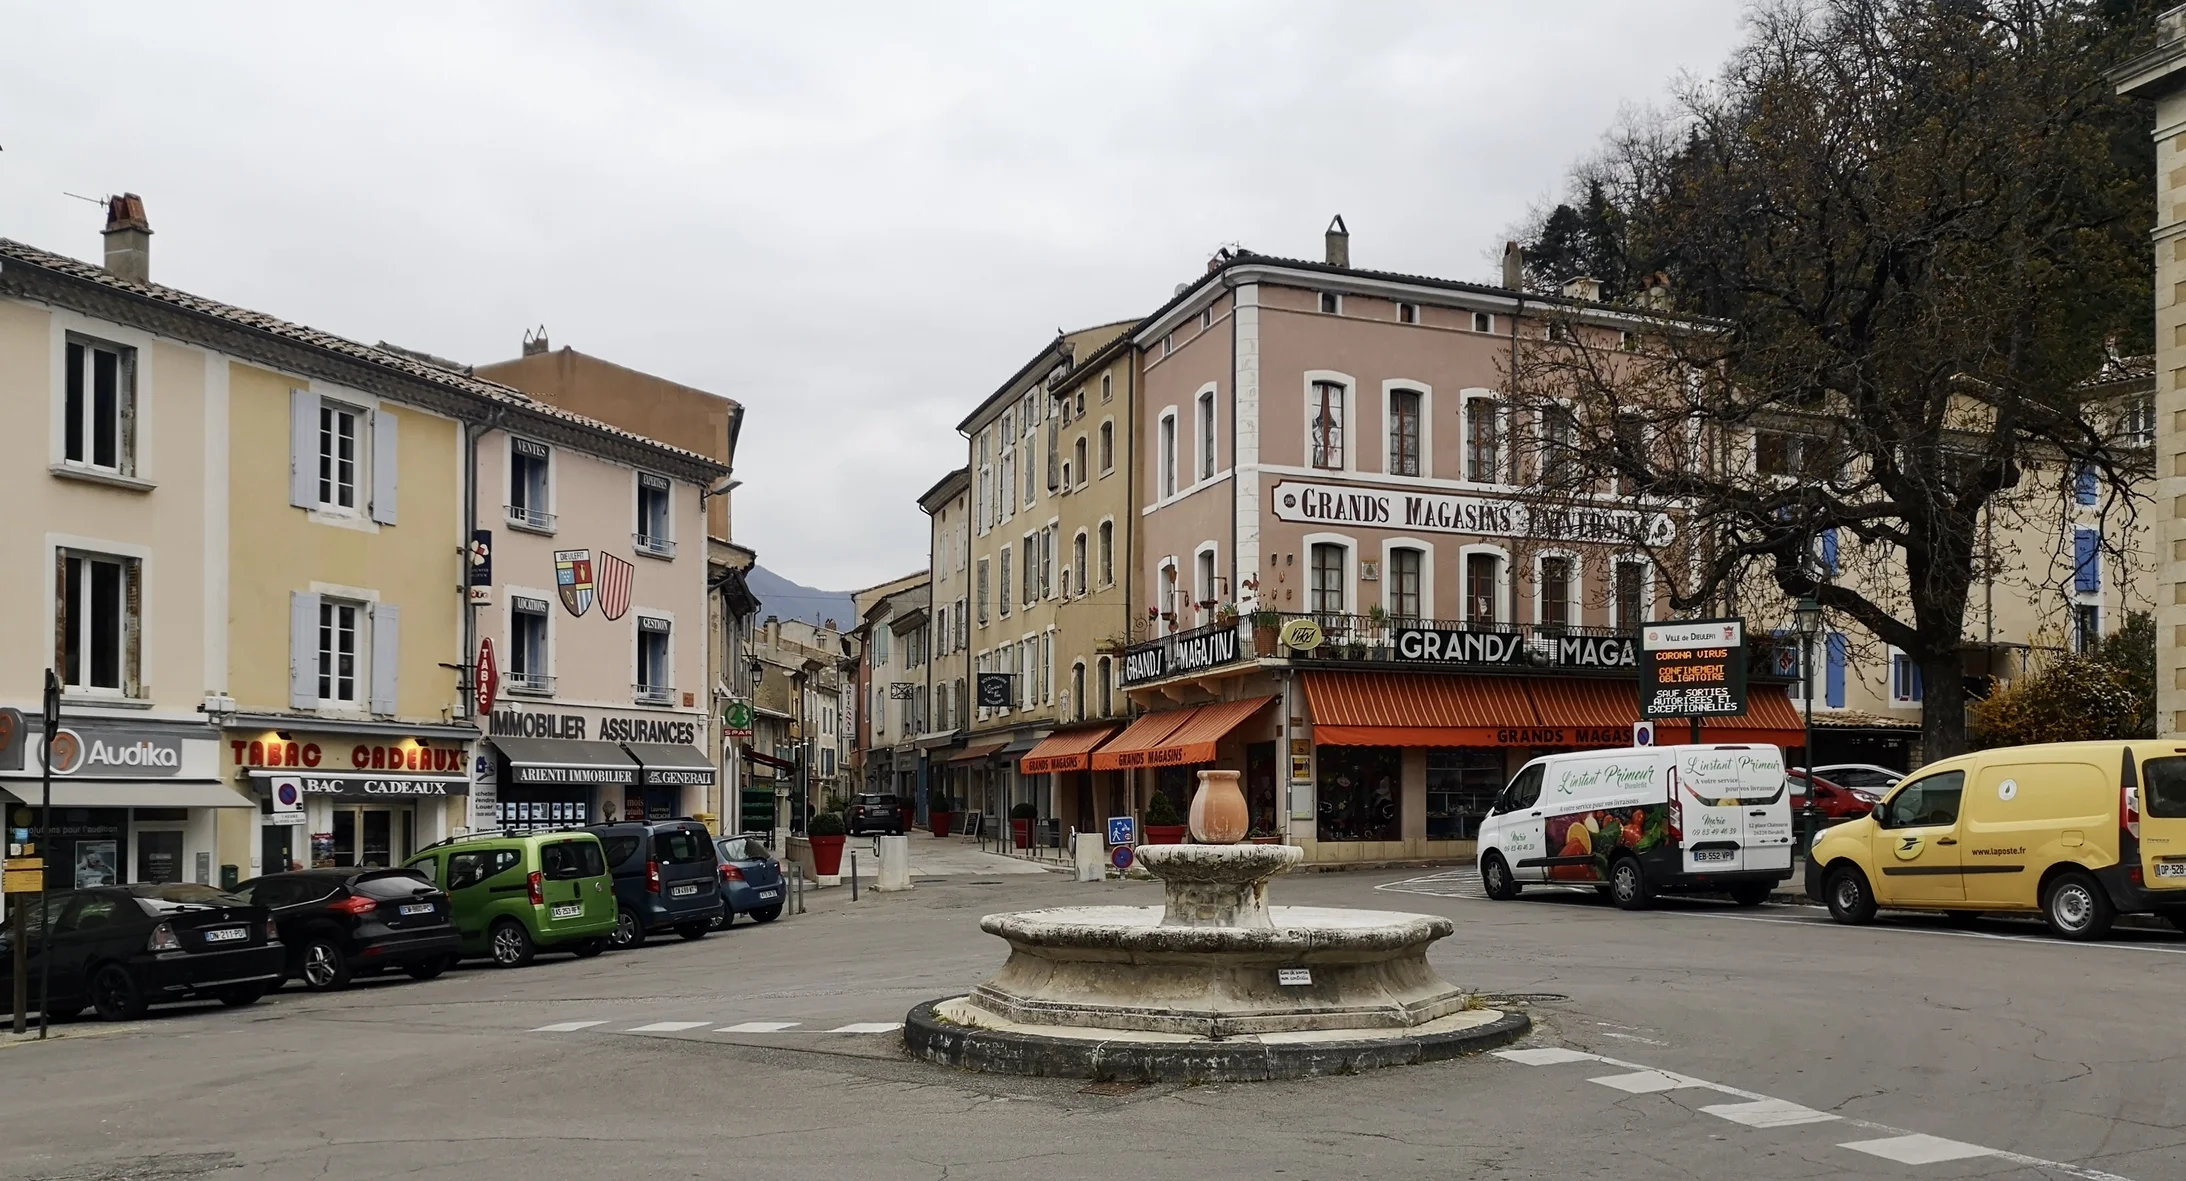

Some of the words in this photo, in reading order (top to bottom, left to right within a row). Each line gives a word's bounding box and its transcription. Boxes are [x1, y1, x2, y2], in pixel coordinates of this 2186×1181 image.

[517, 440, 546, 458] VENTES
[1301, 487, 1390, 524] GRANDS
[1405, 496, 1512, 533] MAGASINS
[560, 551, 585, 561] DIEULEFIT
[517, 597, 547, 613] LOCATIONS
[643, 617, 669, 631] GESTION
[1665, 634, 1680, 642] VILLE
[1126, 649, 1163, 681] GRANDS
[1180, 629, 1235, 669] MAGASINS
[1400, 630, 1521, 663] GRANDS
[1559, 637, 1638, 666] MAGA
[1656, 651, 1692, 661] CORONA
[1697, 649, 1728, 659] VIRUS
[479, 648, 489, 704] TABAC
[1658, 664, 1725, 675] CONFINEMENT
[1659, 672, 1725, 684] OBLIGATOIRE
[1653, 695, 1714, 707] AUTORISEES
[1718, 694, 1732, 704] ET
[1656, 689, 1681, 699] SAUF
[1685, 687, 1729, 698] SORTIES
[1647, 702, 1738, 714] EXCEPTIONNELLES
[489, 710, 586, 740] IMMOBILIER
[600, 717, 695, 744] ASSURANCES
[1497, 729, 1564, 743] GRANDS
[87, 739, 178, 767] Audika
[231, 740, 322, 768] TABAC
[352, 745, 461, 771] CADEAUX
[1118, 753, 1145, 766] GRANDS
[1147, 748, 1183, 763] MAGASINS
[1029, 759, 1049, 771] GRANDS
[1051, 756, 1078, 769] MAGASINS
[1685, 757, 1735, 776] L'instant
[1738, 755, 1781, 773] Primeur
[520, 768, 566, 781] ARIENTI
[569, 769, 632, 783] IMMOBILIER
[662, 772, 711, 784] GENERALI
[1557, 770, 1602, 795] L'instant
[1604, 764, 1655, 787] Primeur
[300, 778, 344, 793] BAC
[364, 781, 447, 795] CADEAUX
[1699, 852, 1729, 860] EB-552-VP
[1972, 846, 2026, 857] www.laposte.fr
